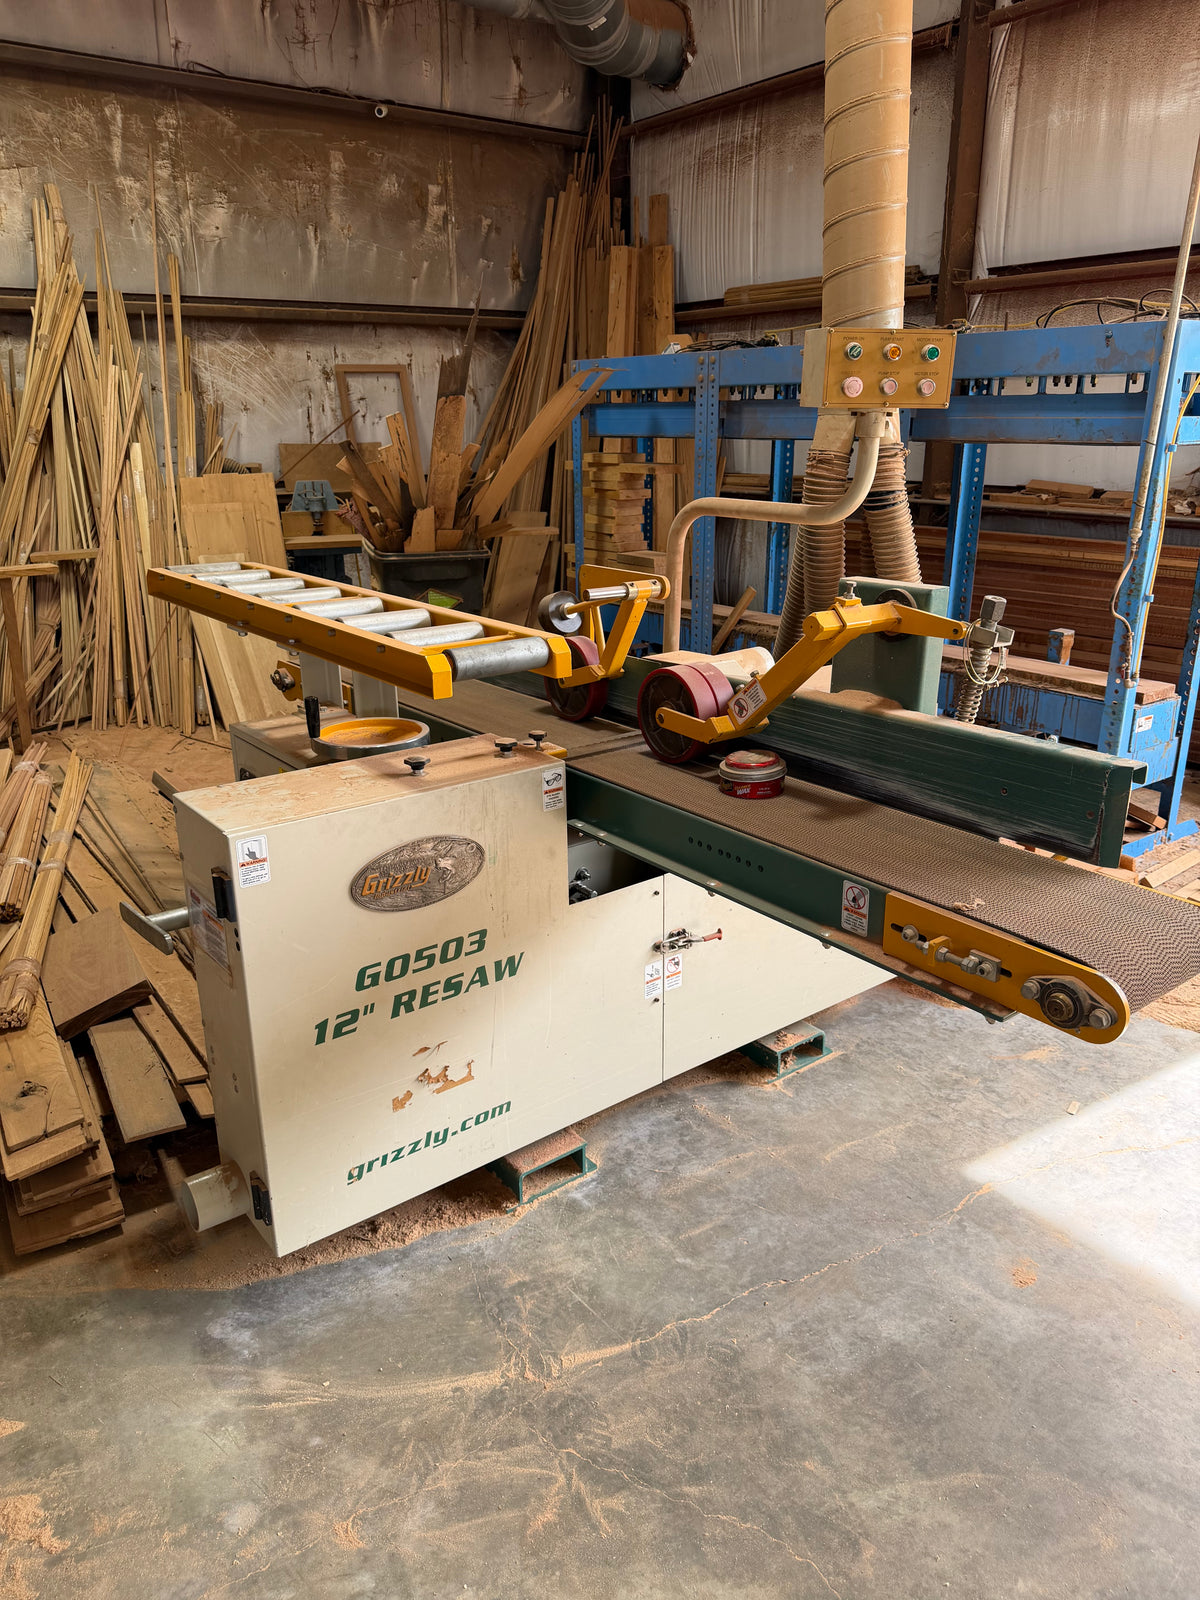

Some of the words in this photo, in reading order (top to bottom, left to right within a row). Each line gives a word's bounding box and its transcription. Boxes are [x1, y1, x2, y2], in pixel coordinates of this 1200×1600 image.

[362, 865, 431, 896] Grizzly
[355, 928, 488, 992] G0503
[314, 1002, 375, 1046] 12"
[390, 951, 525, 1019] RESAW
[347, 1100, 512, 1186] grizzly.com
